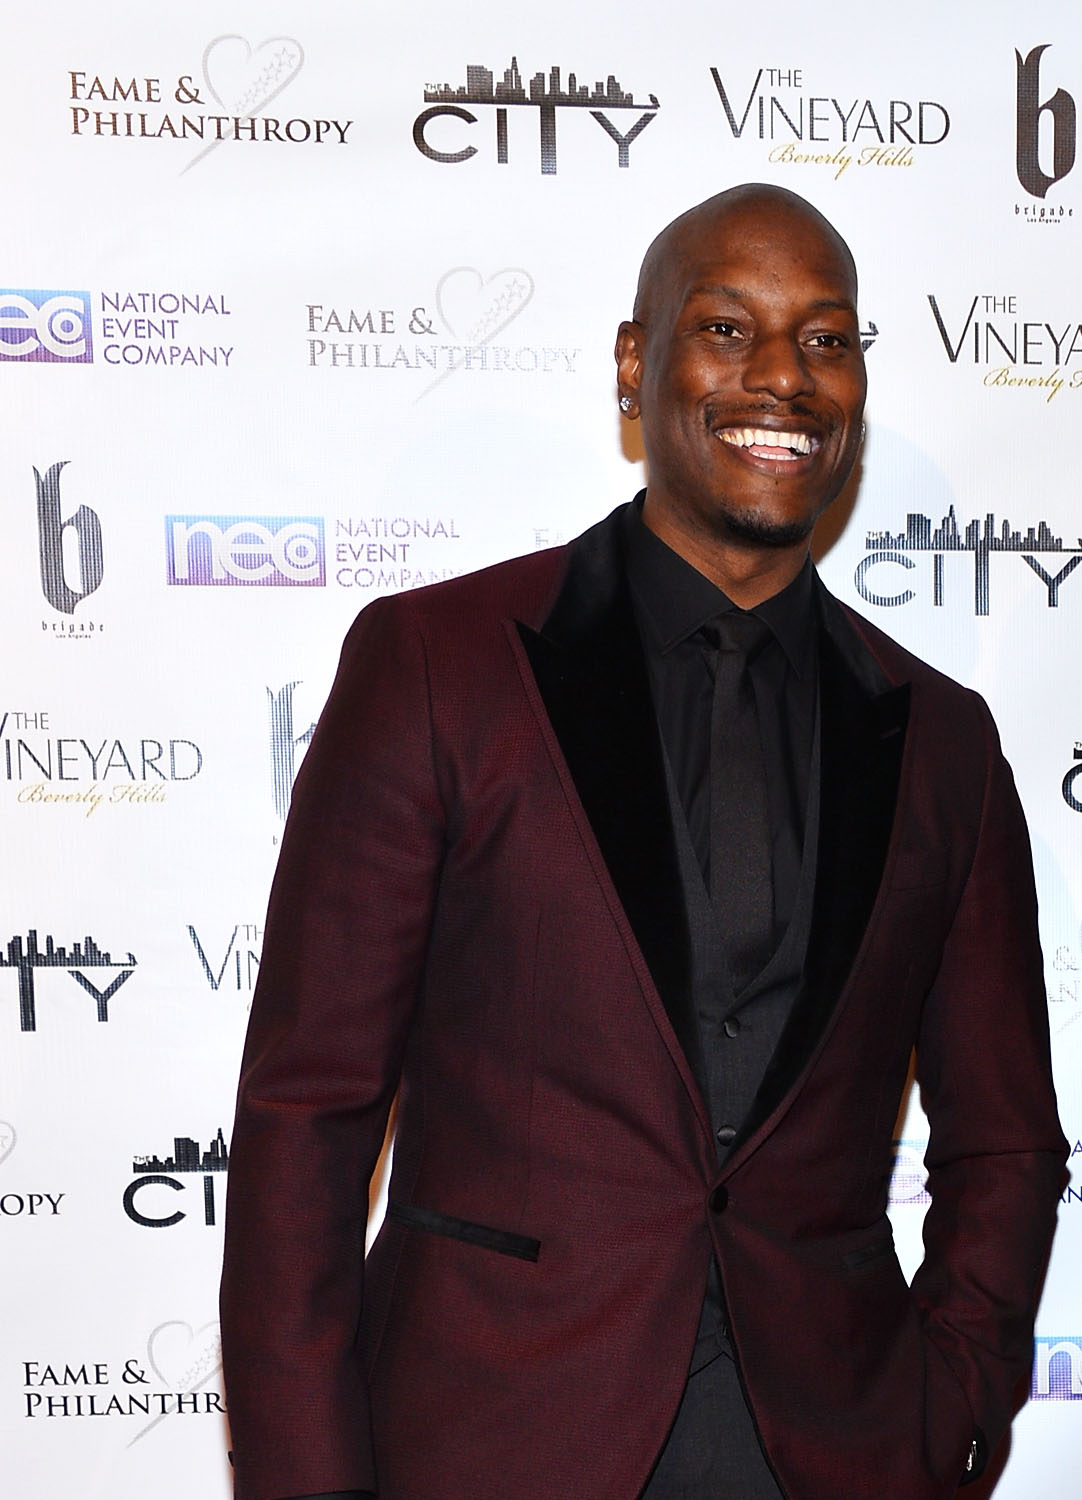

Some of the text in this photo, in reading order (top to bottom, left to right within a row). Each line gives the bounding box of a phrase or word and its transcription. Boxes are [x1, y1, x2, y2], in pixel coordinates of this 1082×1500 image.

[68, 71, 205, 105] FAME &
[765, 68, 803, 88] THE
[710, 67, 951, 146] VINEYARD
[68, 106, 354, 145] PHILANTHROPY
[412, 102, 656, 175] CITY
[768, 144, 916, 180] Beverly Hills
[1014, 203, 1074, 218] brigade
[102, 292, 231, 316] NATIONAL
[982, 296, 1017, 315] THE
[102, 317, 177, 340] EVENT
[307, 305, 438, 336] FAME &
[103, 343, 234, 368] COMPANY
[308, 341, 582, 373] PHILANTHROPY
[984, 368, 1064, 403] Beverly
[336, 517, 460, 539] NATIONAL
[336, 543, 410, 563] EVENT
[12, 713, 49, 730] THE
[18, 782, 167, 818] Beverly Hills
[18, 965, 135, 1032] TY
[123, 1175, 216, 1228] CI
[23, 1359, 150, 1386] FAME &
[24, 1392, 225, 1418] PHILANTHR
